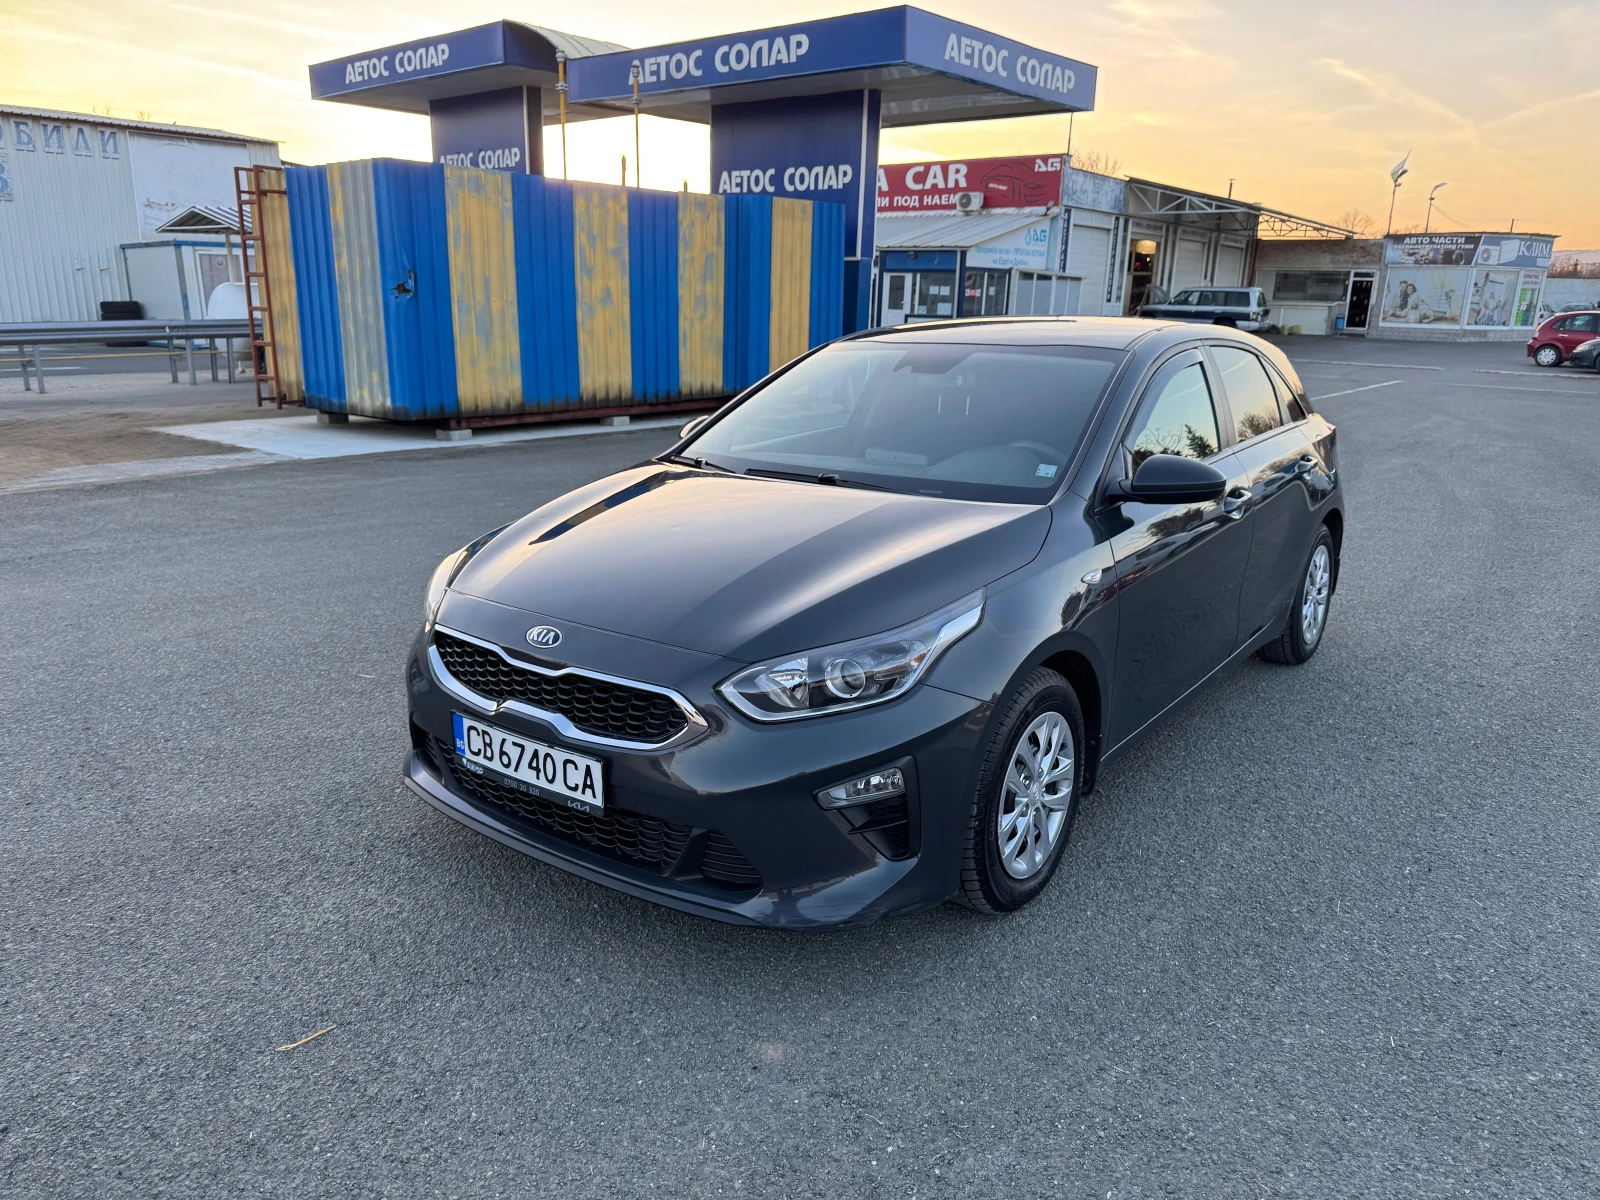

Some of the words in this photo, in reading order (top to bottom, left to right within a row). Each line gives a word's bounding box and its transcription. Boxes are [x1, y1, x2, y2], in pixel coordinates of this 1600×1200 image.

[345, 55, 389, 84] АЕТОС
[395, 43, 450, 73] СОЛАР
[628, 49, 703, 86] АЕТОС
[714, 33, 810, 73] СОЛАР
[944, 32, 1009, 78] АЕТОС
[1016, 55, 1076, 94] СОЛАР
[478, 147, 521, 170] СОЛАР
[718, 168, 776, 194] АЕТОС
[783, 164, 853, 192] СОЛАР
[905, 163, 968, 190] CAR
[893, 195, 919, 208] ПОД
[923, 193, 959, 206] НАЕМ
[1403, 236, 1430, 244] АВТО
[1431, 236, 1466, 244] ЧАСТИ
[1518, 241, 1552, 258] КЛИМ
[530, 627, 555, 645] KIA
[456, 738, 465, 750] BG
[498, 737, 557, 785] 6740
[503, 778, 518, 788] 0700
[528, 786, 540, 796] 320
